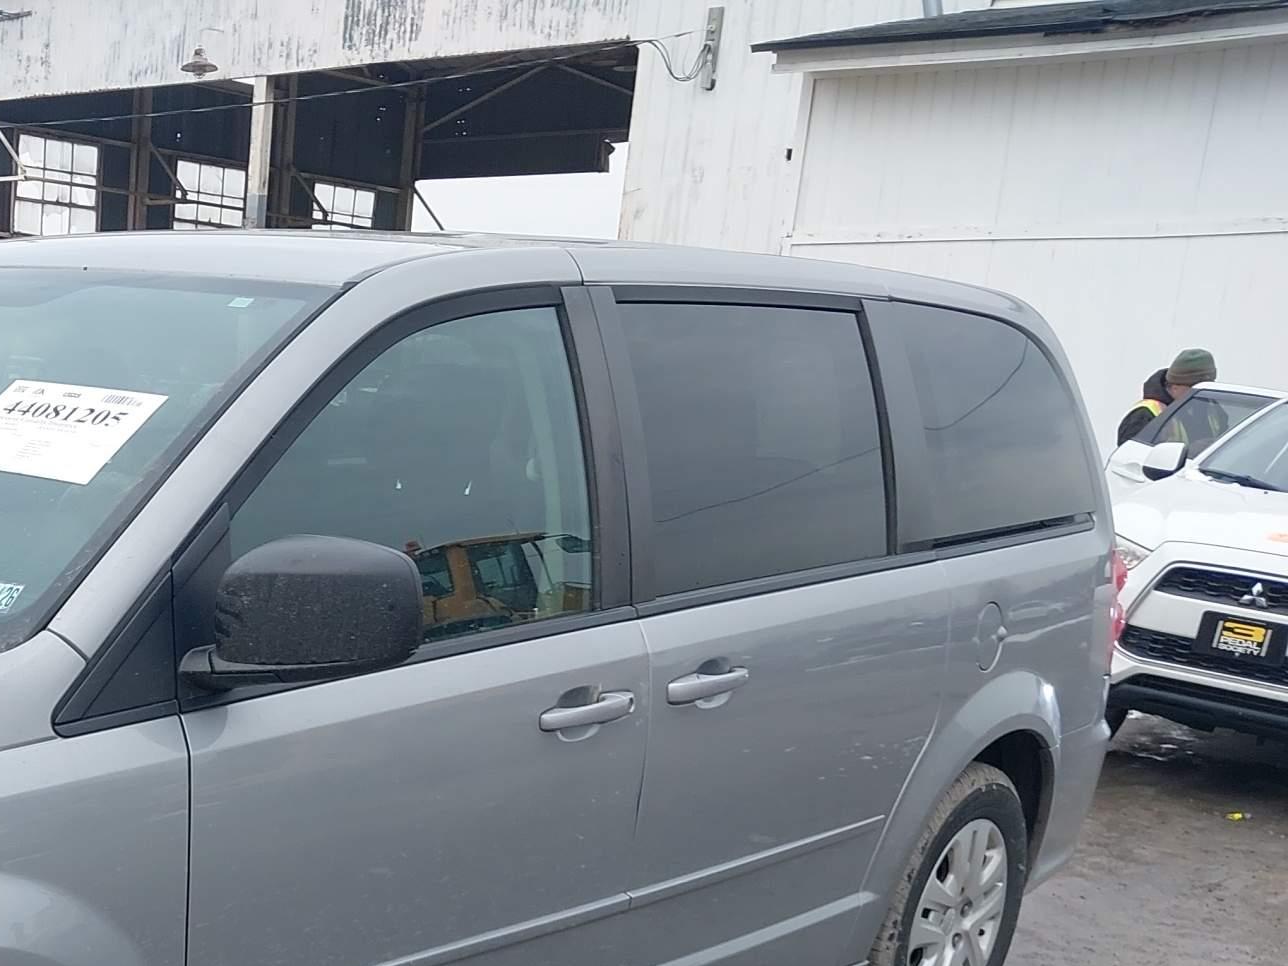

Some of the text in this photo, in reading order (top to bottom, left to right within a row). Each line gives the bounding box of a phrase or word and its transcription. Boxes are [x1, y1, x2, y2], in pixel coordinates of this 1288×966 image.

[3, 400, 129, 427] 44081205
[1217, 643, 1261, 656] SOCIETY
[1220, 635, 1261, 650] PEDAL
